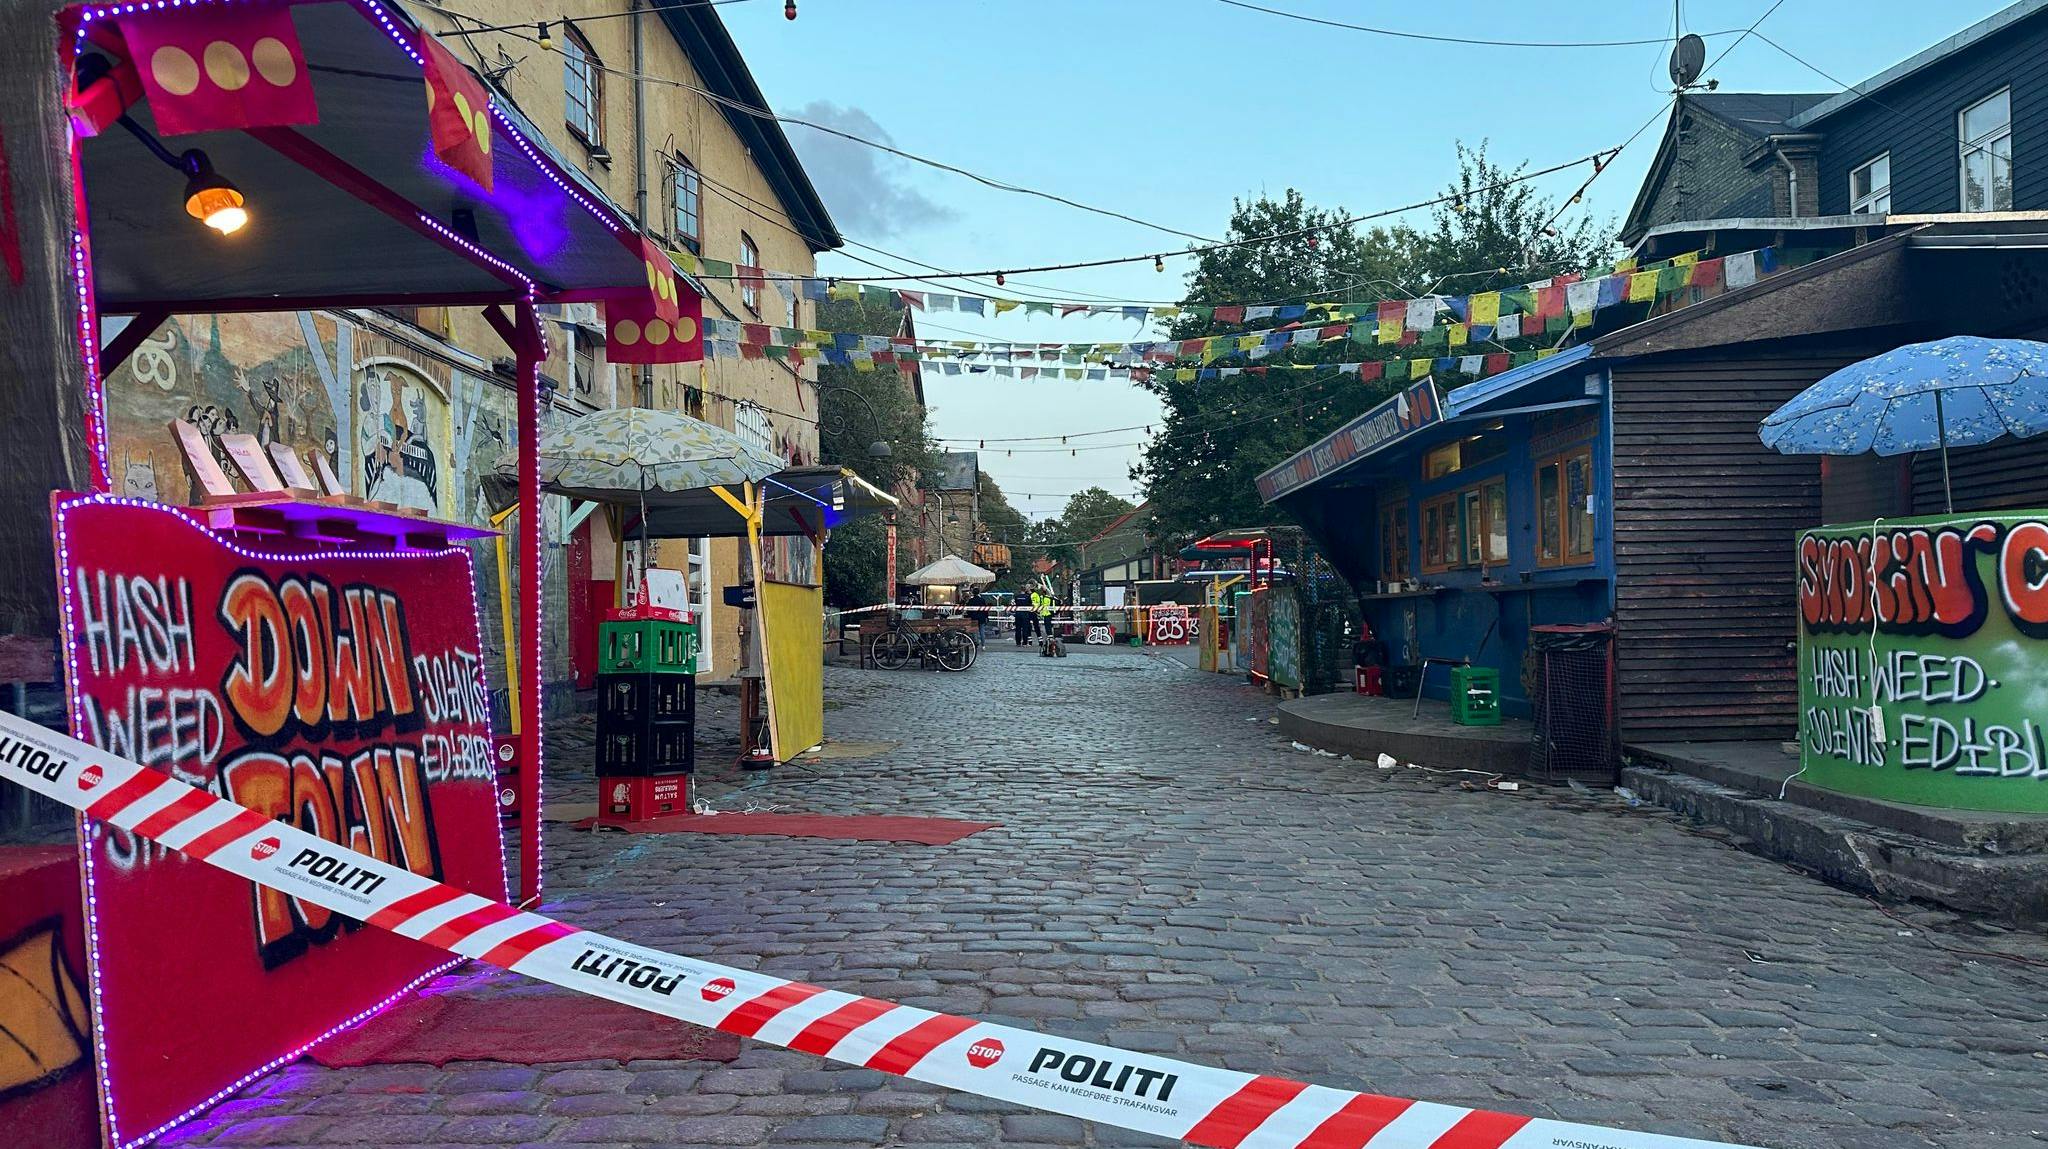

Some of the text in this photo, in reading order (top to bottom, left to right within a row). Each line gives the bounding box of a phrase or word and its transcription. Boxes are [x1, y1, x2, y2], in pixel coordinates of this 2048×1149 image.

[77, 566, 196, 677] HASH
[220, 571, 418, 738] DOWN
[1812, 646, 1986, 702] HASH WEED
[413, 646, 487, 726] JOINTS
[82, 685, 225, 767] WEED
[80, 771, 101, 785] STOP
[422, 728, 493, 782] EDIBLES
[225, 748, 435, 948] TOWN
[254, 841, 277, 855] STOP
[288, 848, 388, 895] POLITI
[571, 949, 687, 996] POLITI
[705, 983, 735, 995] STOP
[969, 1044, 1002, 1059] STOP
[1027, 1047, 1179, 1102] POLITI
[1012, 1073, 1179, 1118] PASSAGE KAN MEDFØRE STRAFANSVAR
